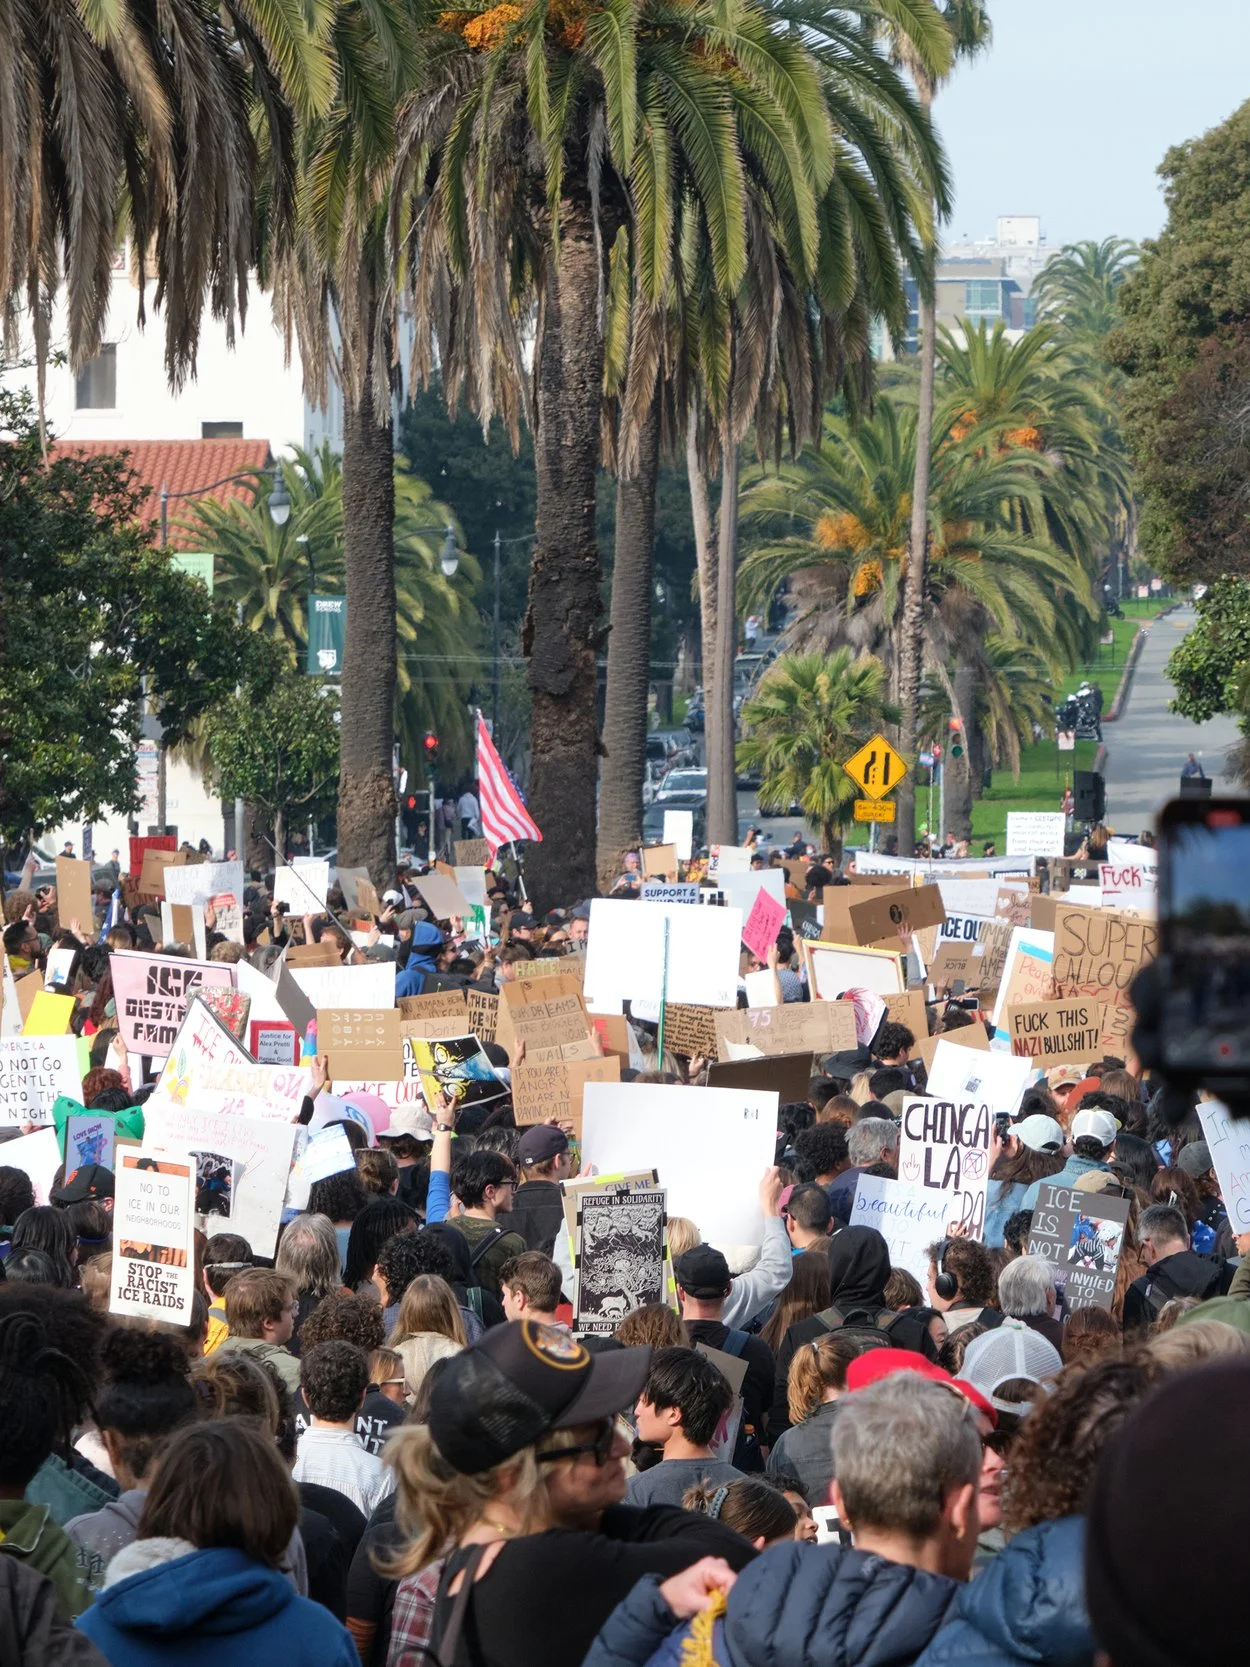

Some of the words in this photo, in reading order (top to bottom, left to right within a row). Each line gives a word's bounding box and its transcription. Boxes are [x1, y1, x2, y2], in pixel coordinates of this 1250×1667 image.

[1101, 866, 1141, 888] FUCK
[644, 888, 688, 898] SUPPORT
[690, 888, 696, 897] &
[941, 917, 962, 937] ICE
[964, 920, 980, 941] OU
[1062, 913, 1159, 963] SUPER
[1053, 954, 1134, 990] CALLOU
[147, 966, 203, 998] ICE
[470, 994, 487, 1008] THE
[1055, 984, 1133, 1009] FASCIS
[510, 1006, 529, 1020] OUR
[531, 998, 576, 1018] DREAMS
[468, 1012, 484, 1026] ICE
[520, 1022, 538, 1034] ARE
[1014, 1012, 1049, 1034] FUCK
[1056, 1007, 1088, 1029] THIS
[133, 1022, 178, 1045] FAM
[1013, 1036, 1042, 1057] NAZI
[1044, 1028, 1099, 1055] BULLSHIT!
[0, 1042, 46, 1051] MERICA
[536, 1045, 580, 1062] WALLS
[10, 1057, 38, 1072] NOT
[42, 1056, 62, 1071] GO
[514, 1068, 524, 1081] IF
[526, 1067, 542, 1080] YOU
[544, 1066, 561, 1078] ARE
[518, 1076, 568, 1093] ANGRY
[0, 1091, 28, 1103] NTO
[516, 1094, 535, 1106] YOU
[536, 1091, 557, 1102] ARE
[8, 1108, 47, 1119] NIGH
[516, 1105, 548, 1122] PAYING
[551, 1102, 572, 1117] ATTE
[904, 1102, 990, 1150] CHINGA
[923, 1146, 961, 1190] LA
[140, 1182, 153, 1194] NO
[158, 1185, 170, 1196] TO
[632, 1179, 650, 1190] ME
[128, 1198, 142, 1210] ICE
[146, 1201, 156, 1212] IN
[160, 1204, 180, 1216] OUR
[583, 1196, 610, 1206] REFUGE
[612, 1196, 620, 1204] IN
[622, 1193, 664, 1204] SOLIDARITY
[856, 1192, 949, 1222] beautiful
[1044, 1186, 1084, 1212] ICE
[126, 1214, 181, 1230] NEIGHBORHOODS
[954, 1190, 985, 1240] DA
[1034, 1212, 1060, 1234] IS
[1028, 1240, 1064, 1259] NOT
[128, 1262, 162, 1280] STOP
[166, 1271, 178, 1279] THE
[127, 1276, 178, 1295] RACIST
[1070, 1271, 1114, 1294] INVITED
[1075, 1286, 1094, 1298] TO
[118, 1287, 141, 1302] ICE
[142, 1292, 184, 1310] RAIDS
[578, 1324, 590, 1332] WE
[592, 1322, 614, 1331] NEED
